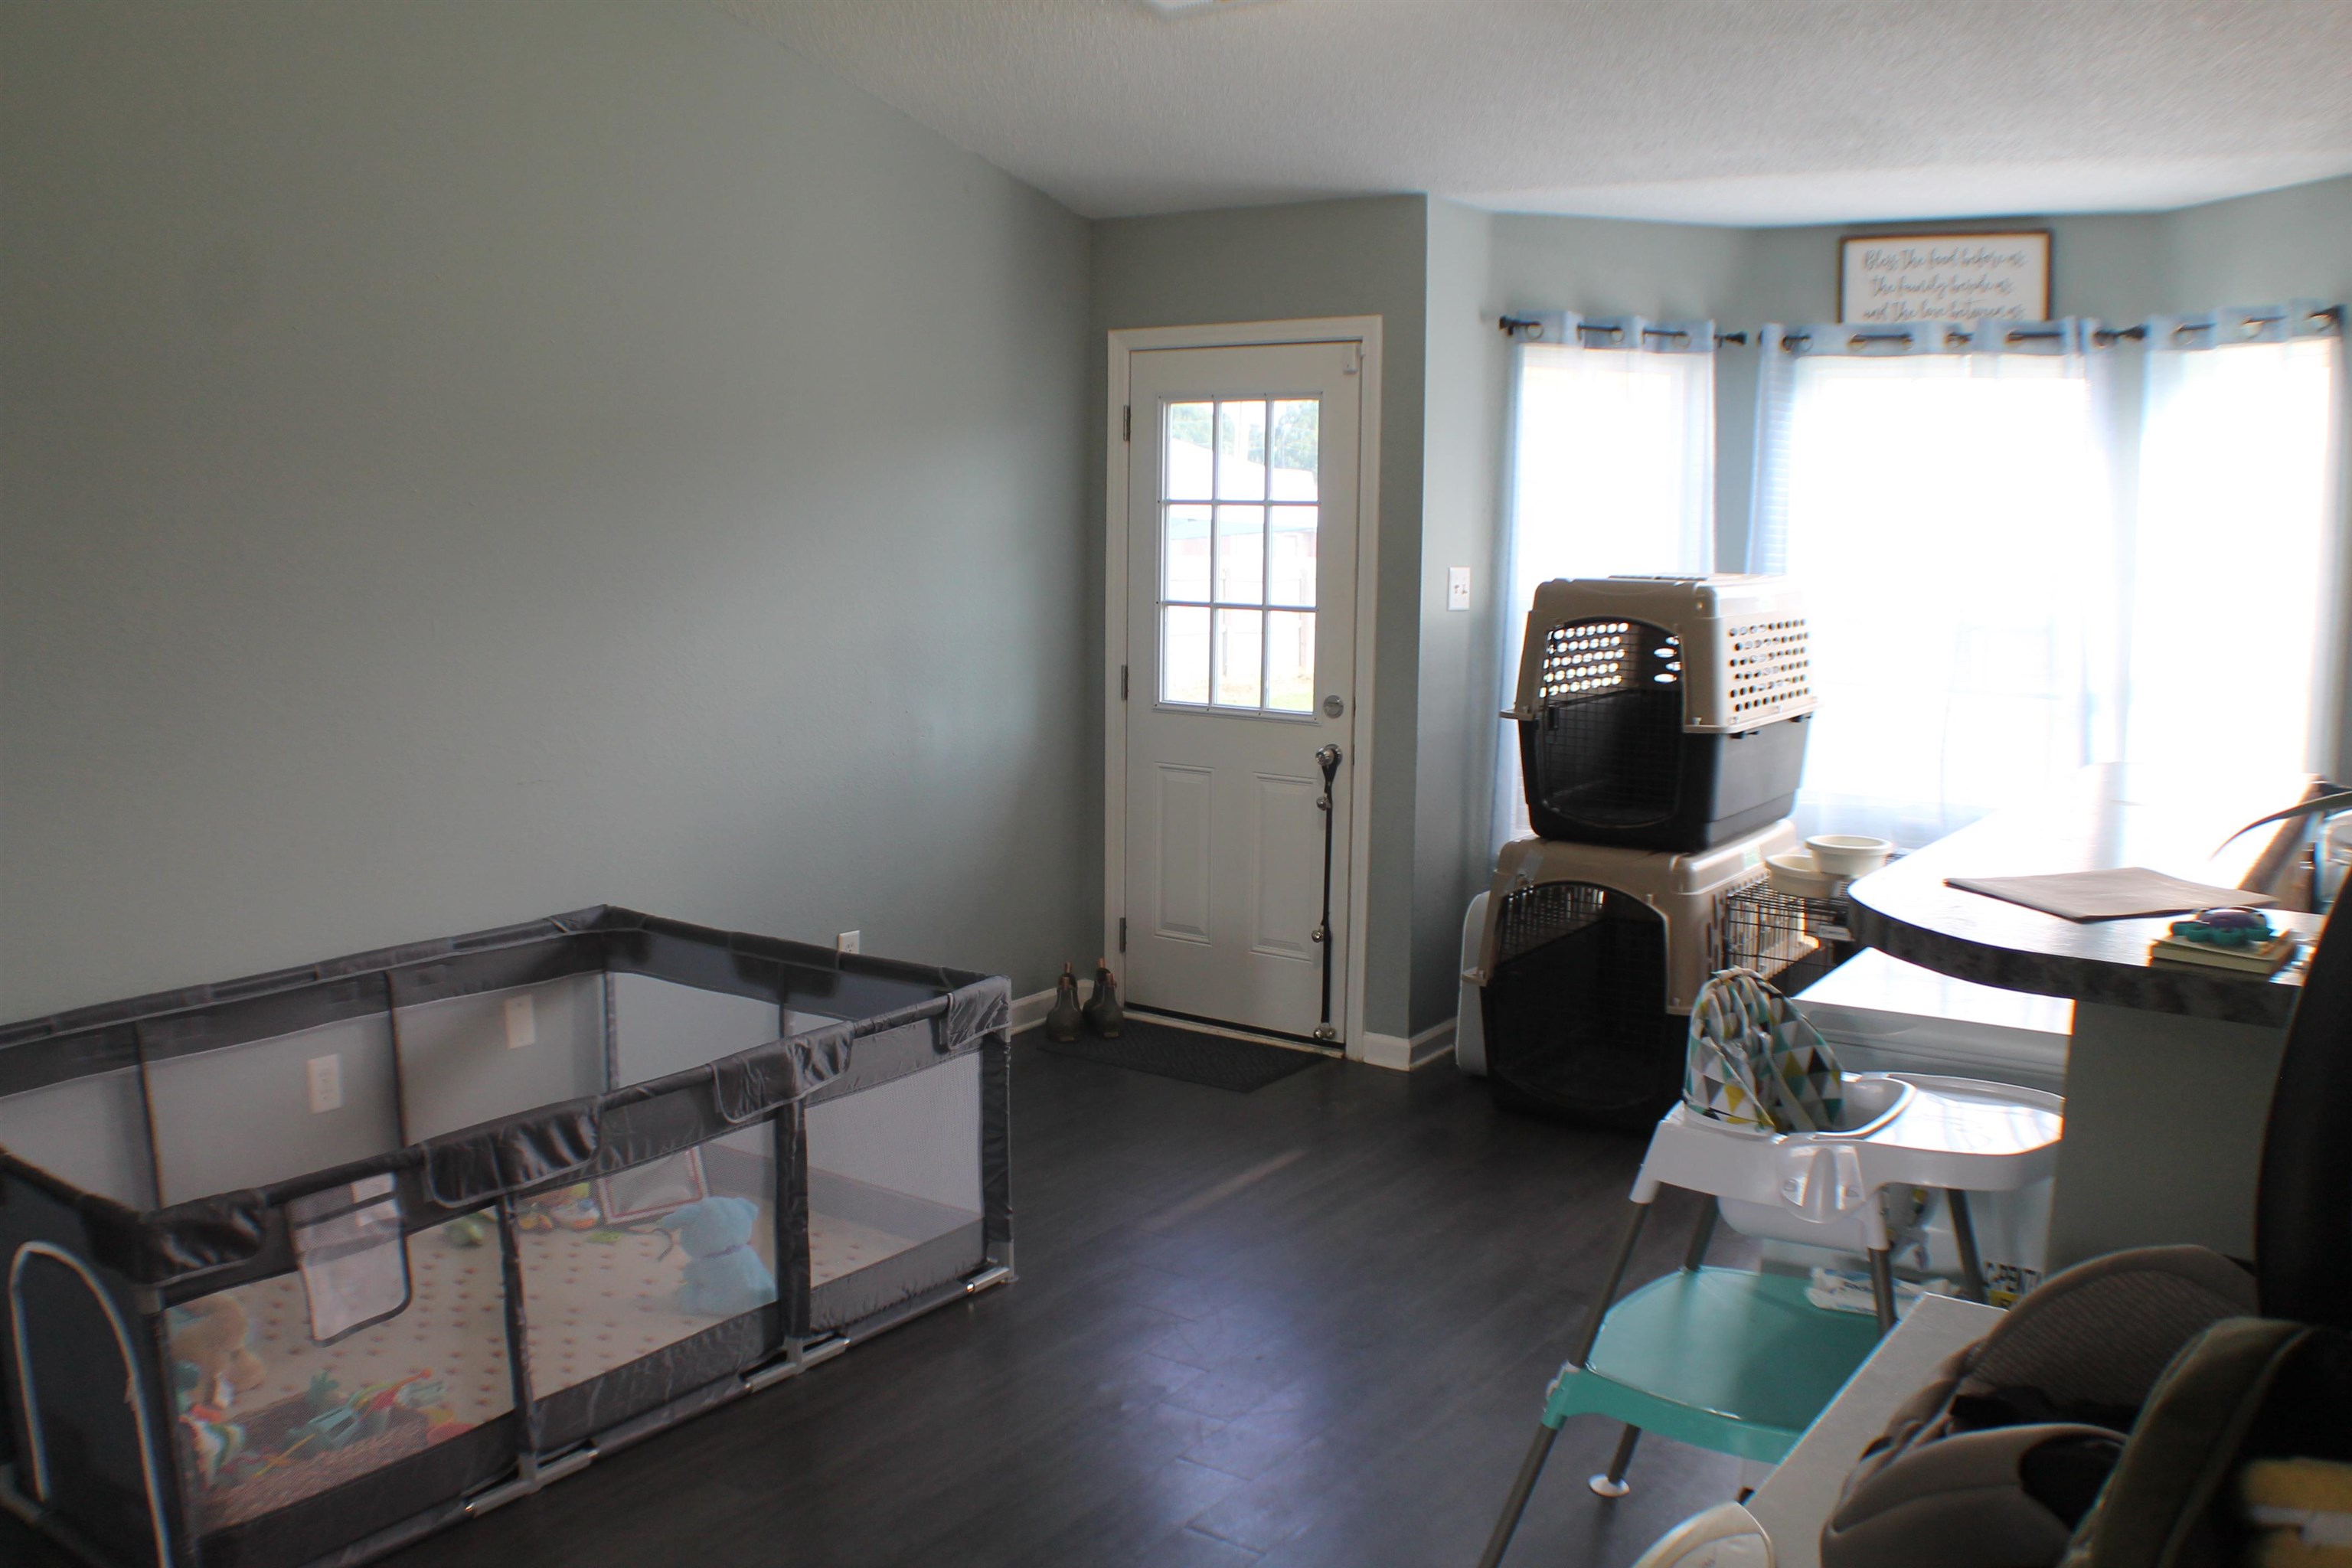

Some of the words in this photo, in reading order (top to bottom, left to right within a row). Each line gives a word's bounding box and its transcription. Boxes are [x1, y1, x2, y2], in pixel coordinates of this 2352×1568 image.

[1864, 248, 1899, 270] Bless
[1927, 246, 1959, 270] food
[1961, 246, 2007, 269] before
[2007, 250, 2028, 268] us
[1899, 273, 1949, 299] family
[1949, 273, 1994, 295] beside
[1995, 277, 2016, 296] us
[1864, 301, 1890, 320] and
[1919, 299, 1949, 318] love
[1949, 297, 2007, 320] between
[2007, 303, 2027, 320] us
